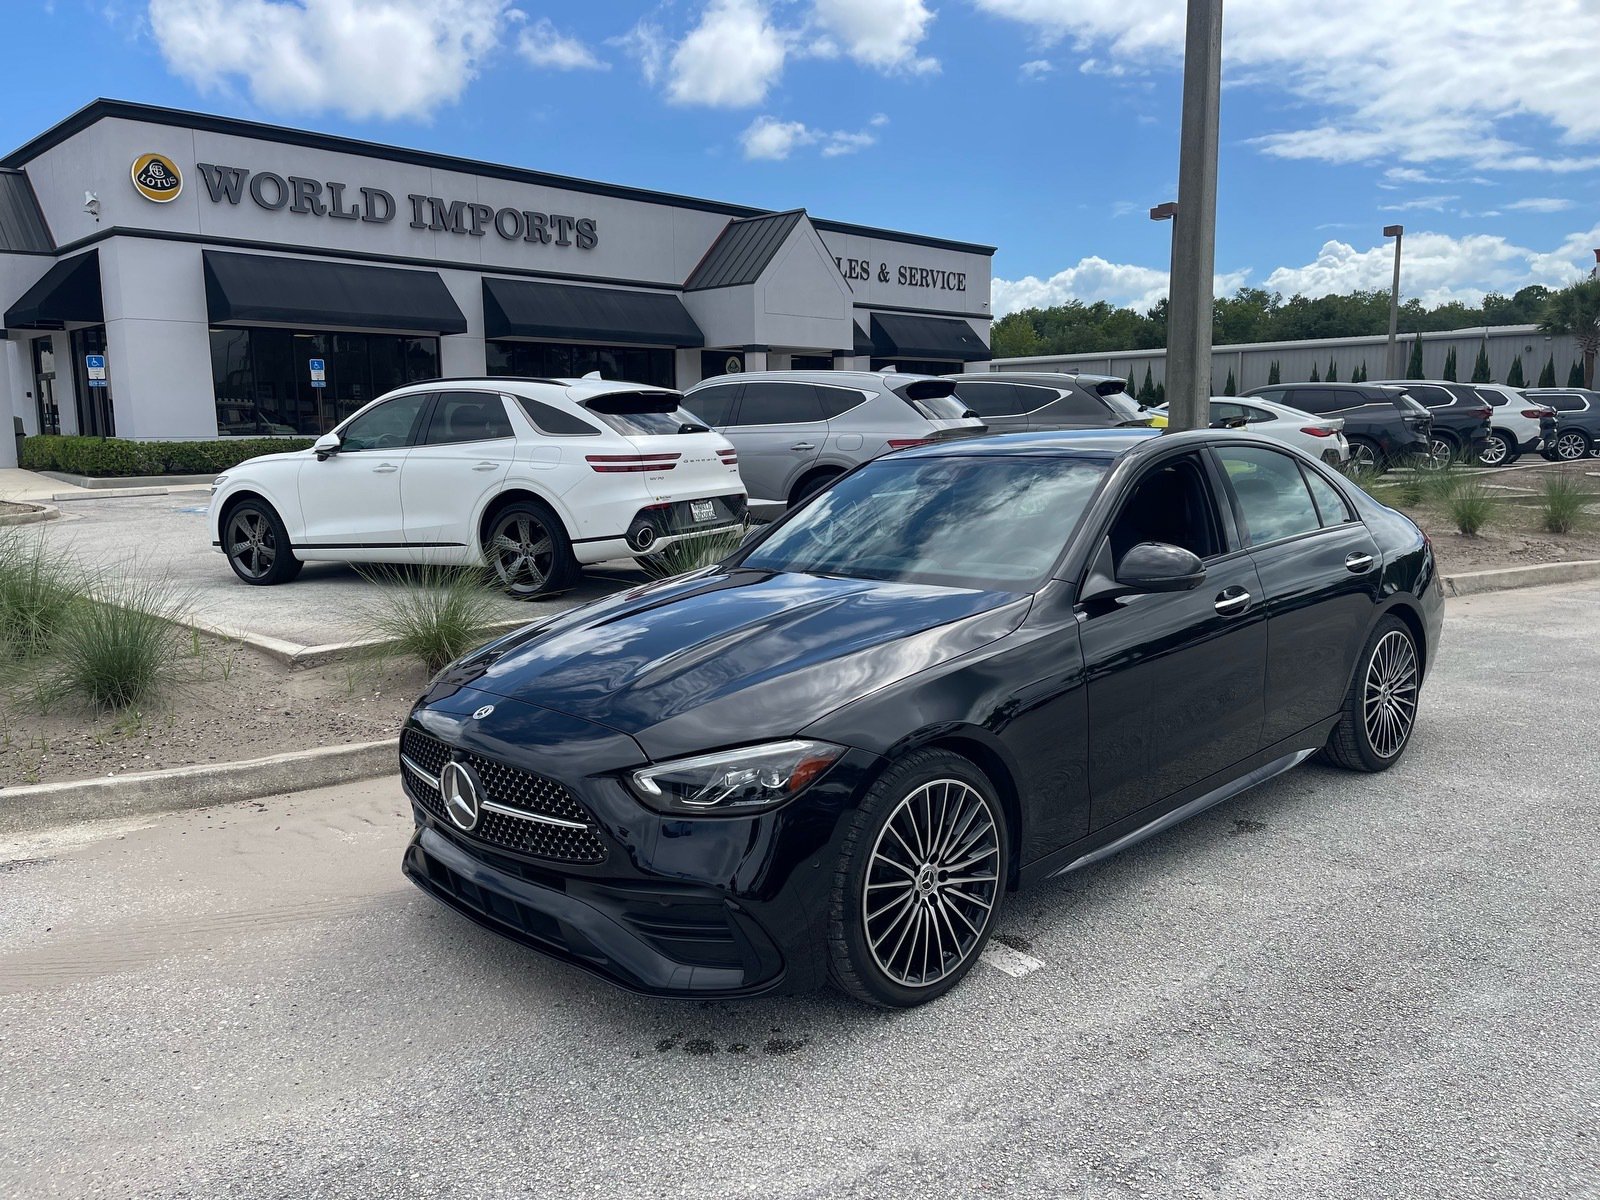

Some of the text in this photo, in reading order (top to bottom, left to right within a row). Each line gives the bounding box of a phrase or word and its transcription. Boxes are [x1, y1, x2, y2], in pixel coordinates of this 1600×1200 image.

[139, 173, 177, 188] LOTUS
[197, 162, 600, 250] WORLD IMPORTS
[877, 262, 890, 283] &
[897, 265, 967, 292] SERVICE
